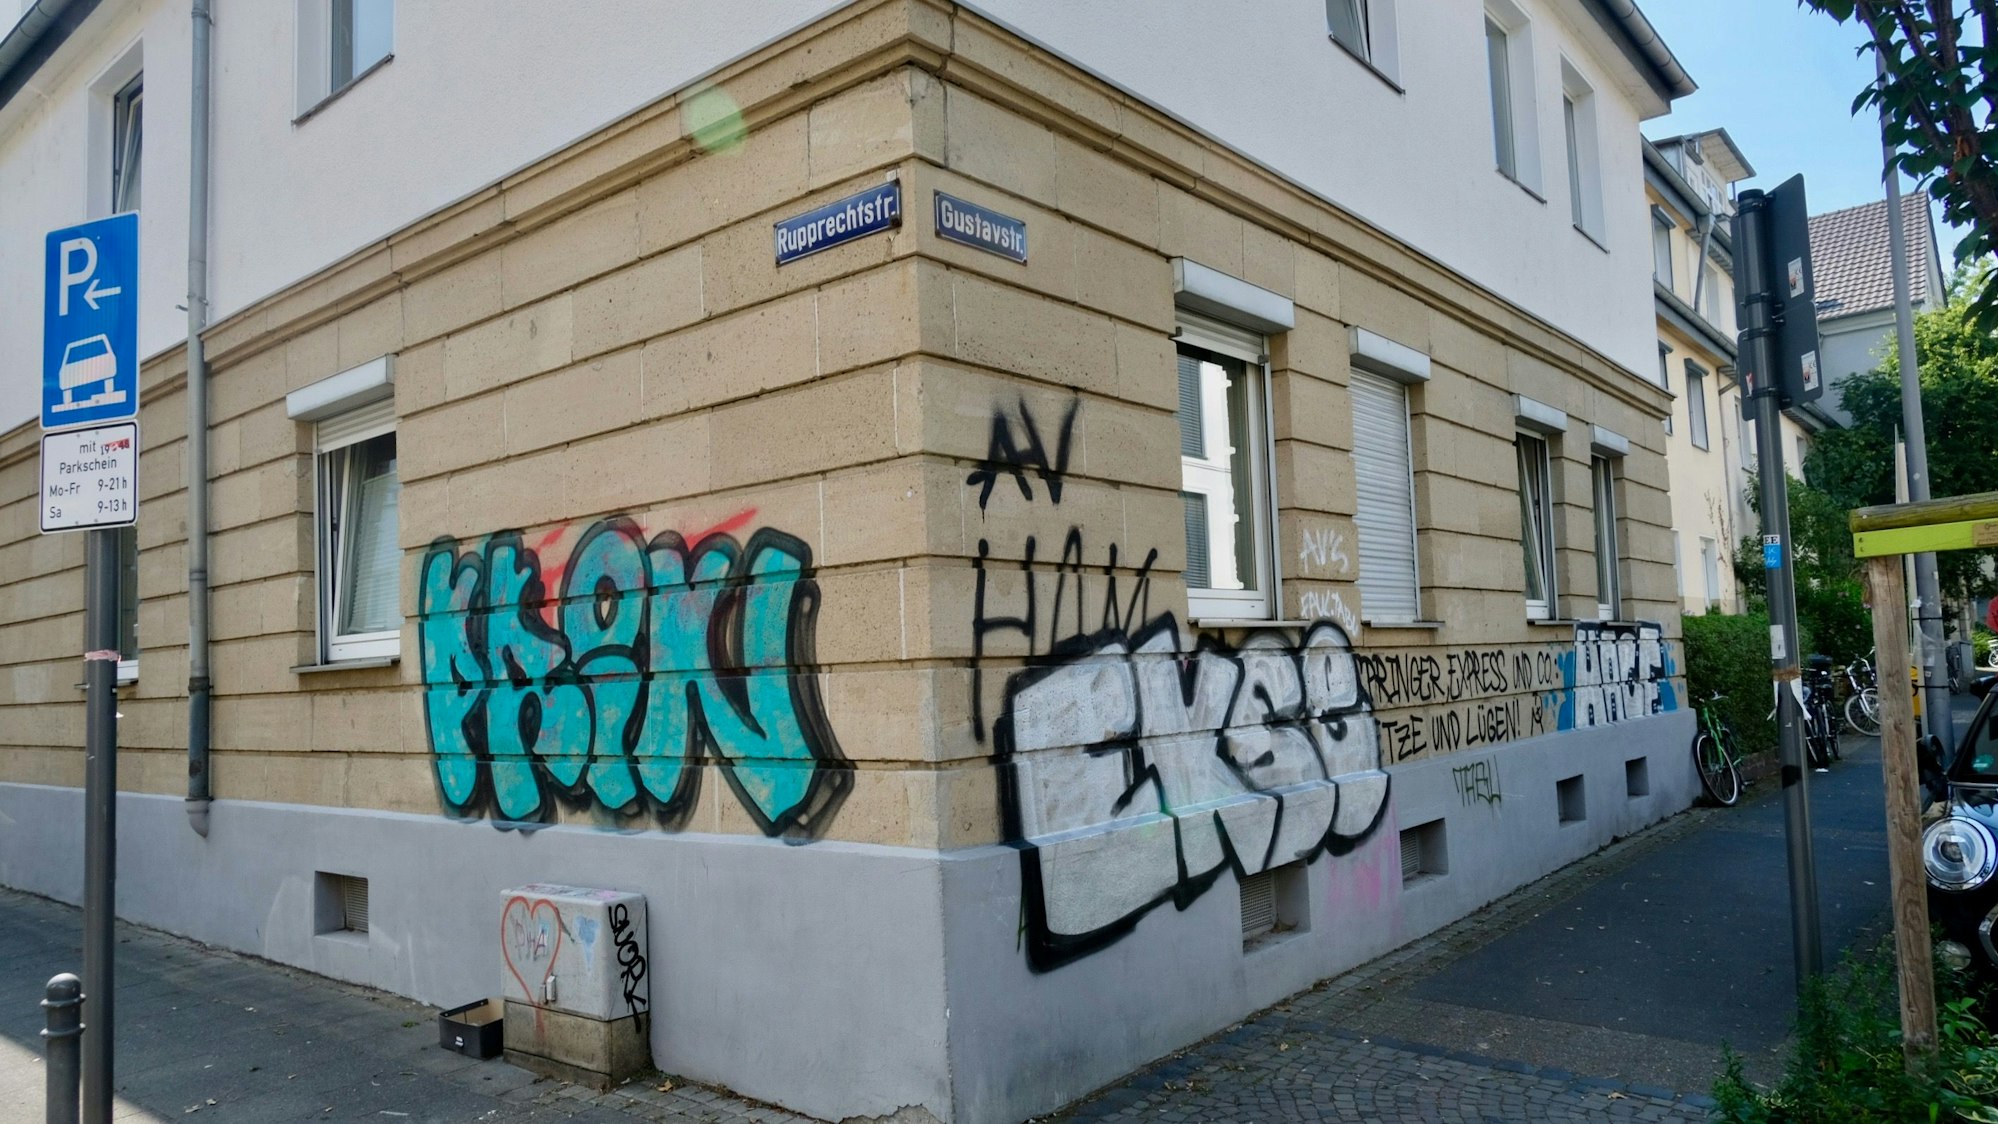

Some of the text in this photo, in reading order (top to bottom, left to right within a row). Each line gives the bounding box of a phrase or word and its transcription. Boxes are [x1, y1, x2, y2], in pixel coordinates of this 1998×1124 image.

[778, 193, 897, 255] Rupprechtstr.
[941, 200, 1024, 254] Gustavstr.
[59, 237, 98, 317] P
[60, 457, 117, 474] Parkschein
[80, 441, 96, 454] mit
[49, 476, 127, 497] Mo-Fr 9-21 h
[49, 498, 127, 519] Sa 9-13 h
[1446, 649, 1508, 700] EXPRESS
[1513, 651, 1532, 690] UND
[1375, 697, 1520, 765] TZE UND LÜGEN!
